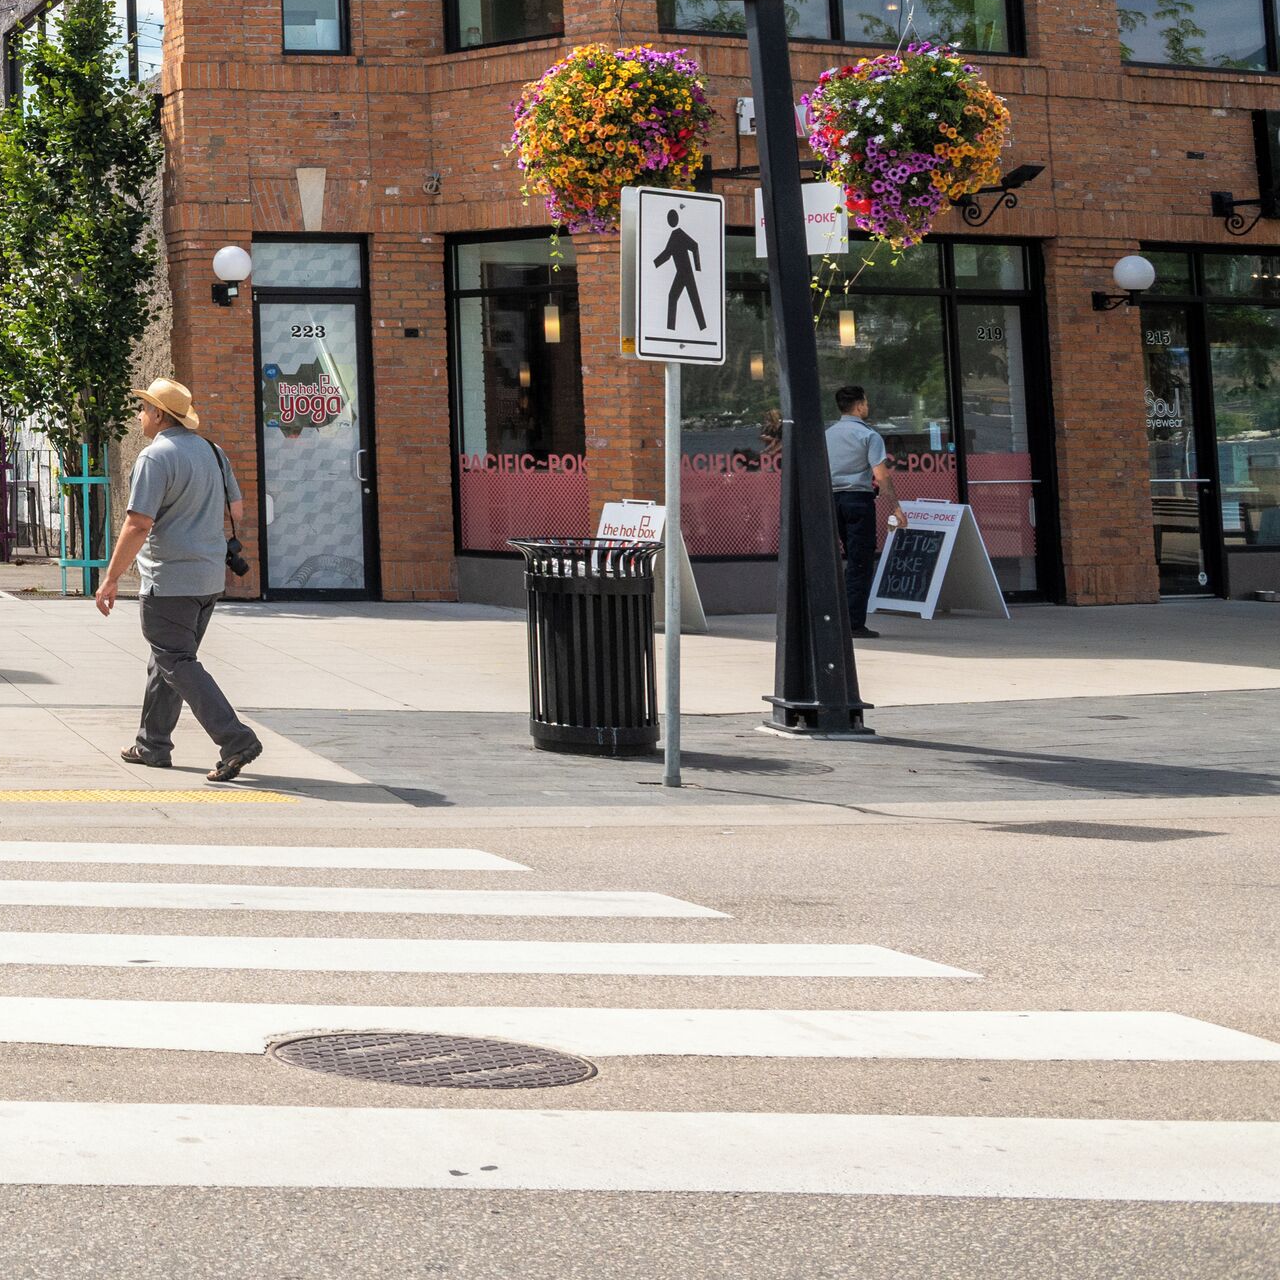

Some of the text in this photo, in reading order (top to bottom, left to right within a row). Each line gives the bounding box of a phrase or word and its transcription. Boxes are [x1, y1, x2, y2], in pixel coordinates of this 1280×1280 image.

[291, 325, 326, 338] 223
[977, 327, 1002, 341] 219
[1146, 331, 1171, 345] 215
[279, 374, 341, 395] the hot box
[279, 395, 343, 423] yoga
[1144, 387, 1182, 418] Soul
[1146, 418, 1183, 428] eyewear
[680, 453, 782, 471] ACIFIC~PO
[603, 515, 656, 538] the hot box
[890, 556, 922, 572] POKE
[886, 575, 917, 595] YOU!
